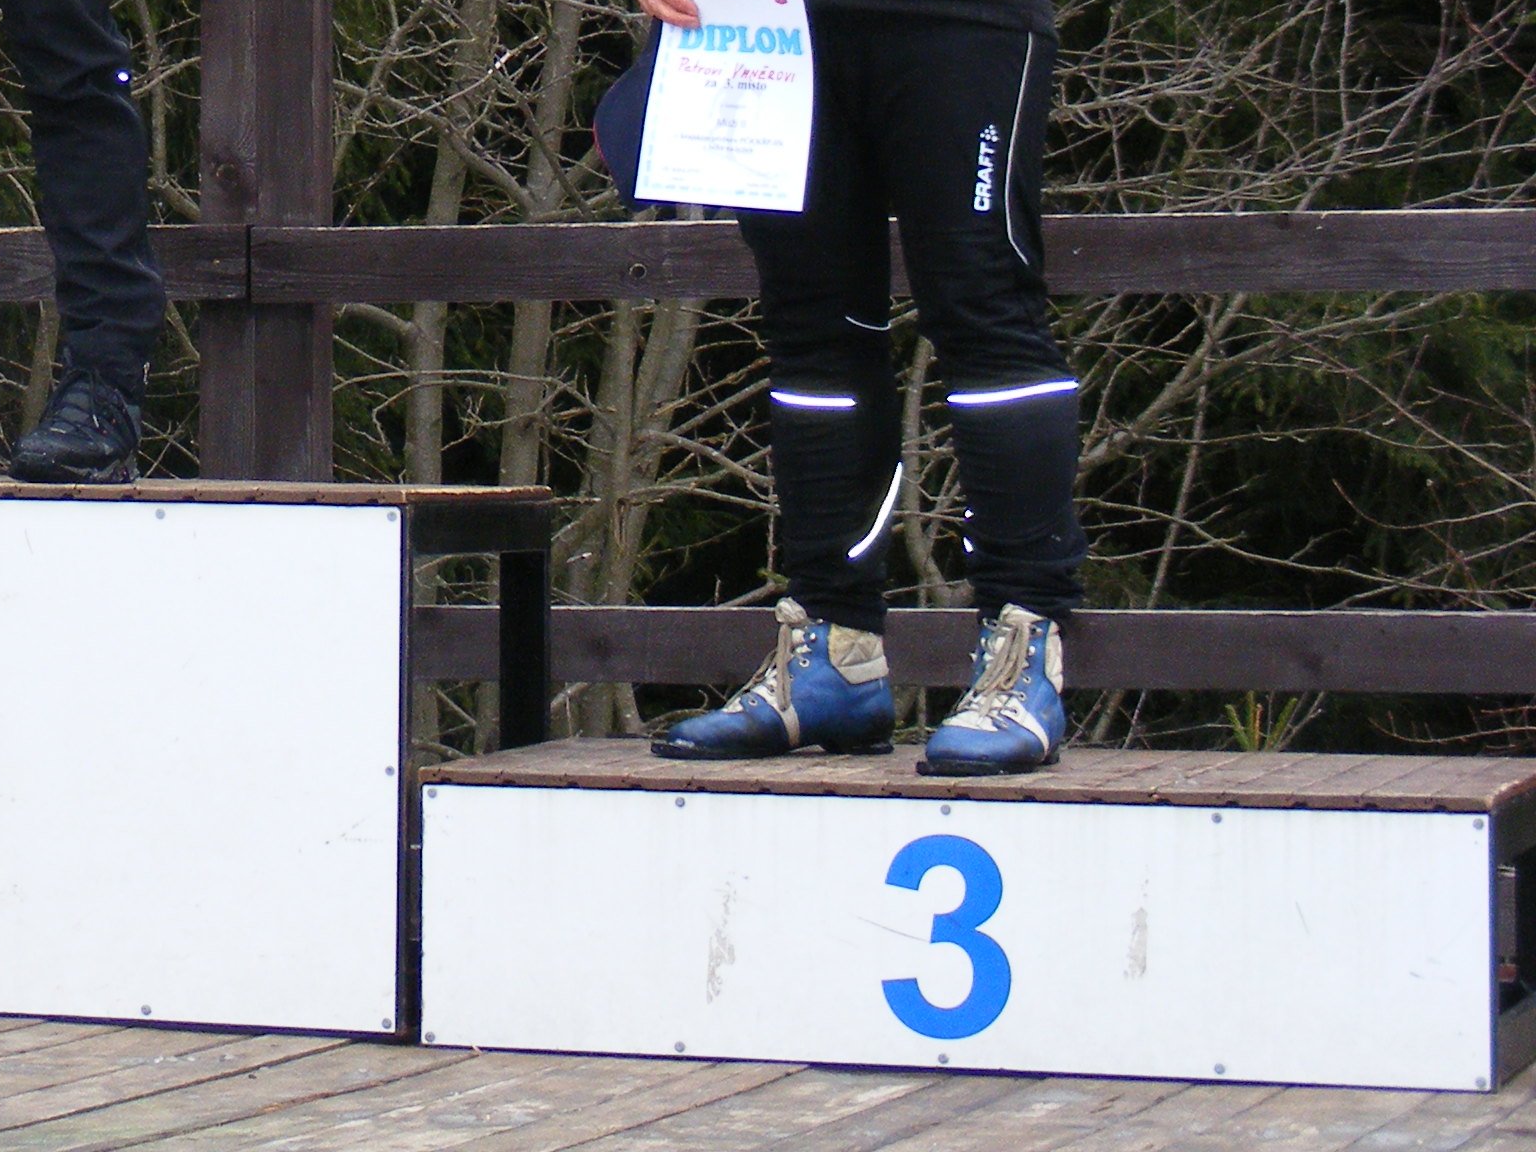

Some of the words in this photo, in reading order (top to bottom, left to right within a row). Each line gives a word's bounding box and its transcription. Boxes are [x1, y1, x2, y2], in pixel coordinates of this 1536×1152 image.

[678, 24, 803, 56] DIPLOM
[973, 141, 995, 211] CRAFT
[881, 834, 1012, 1040] 3
